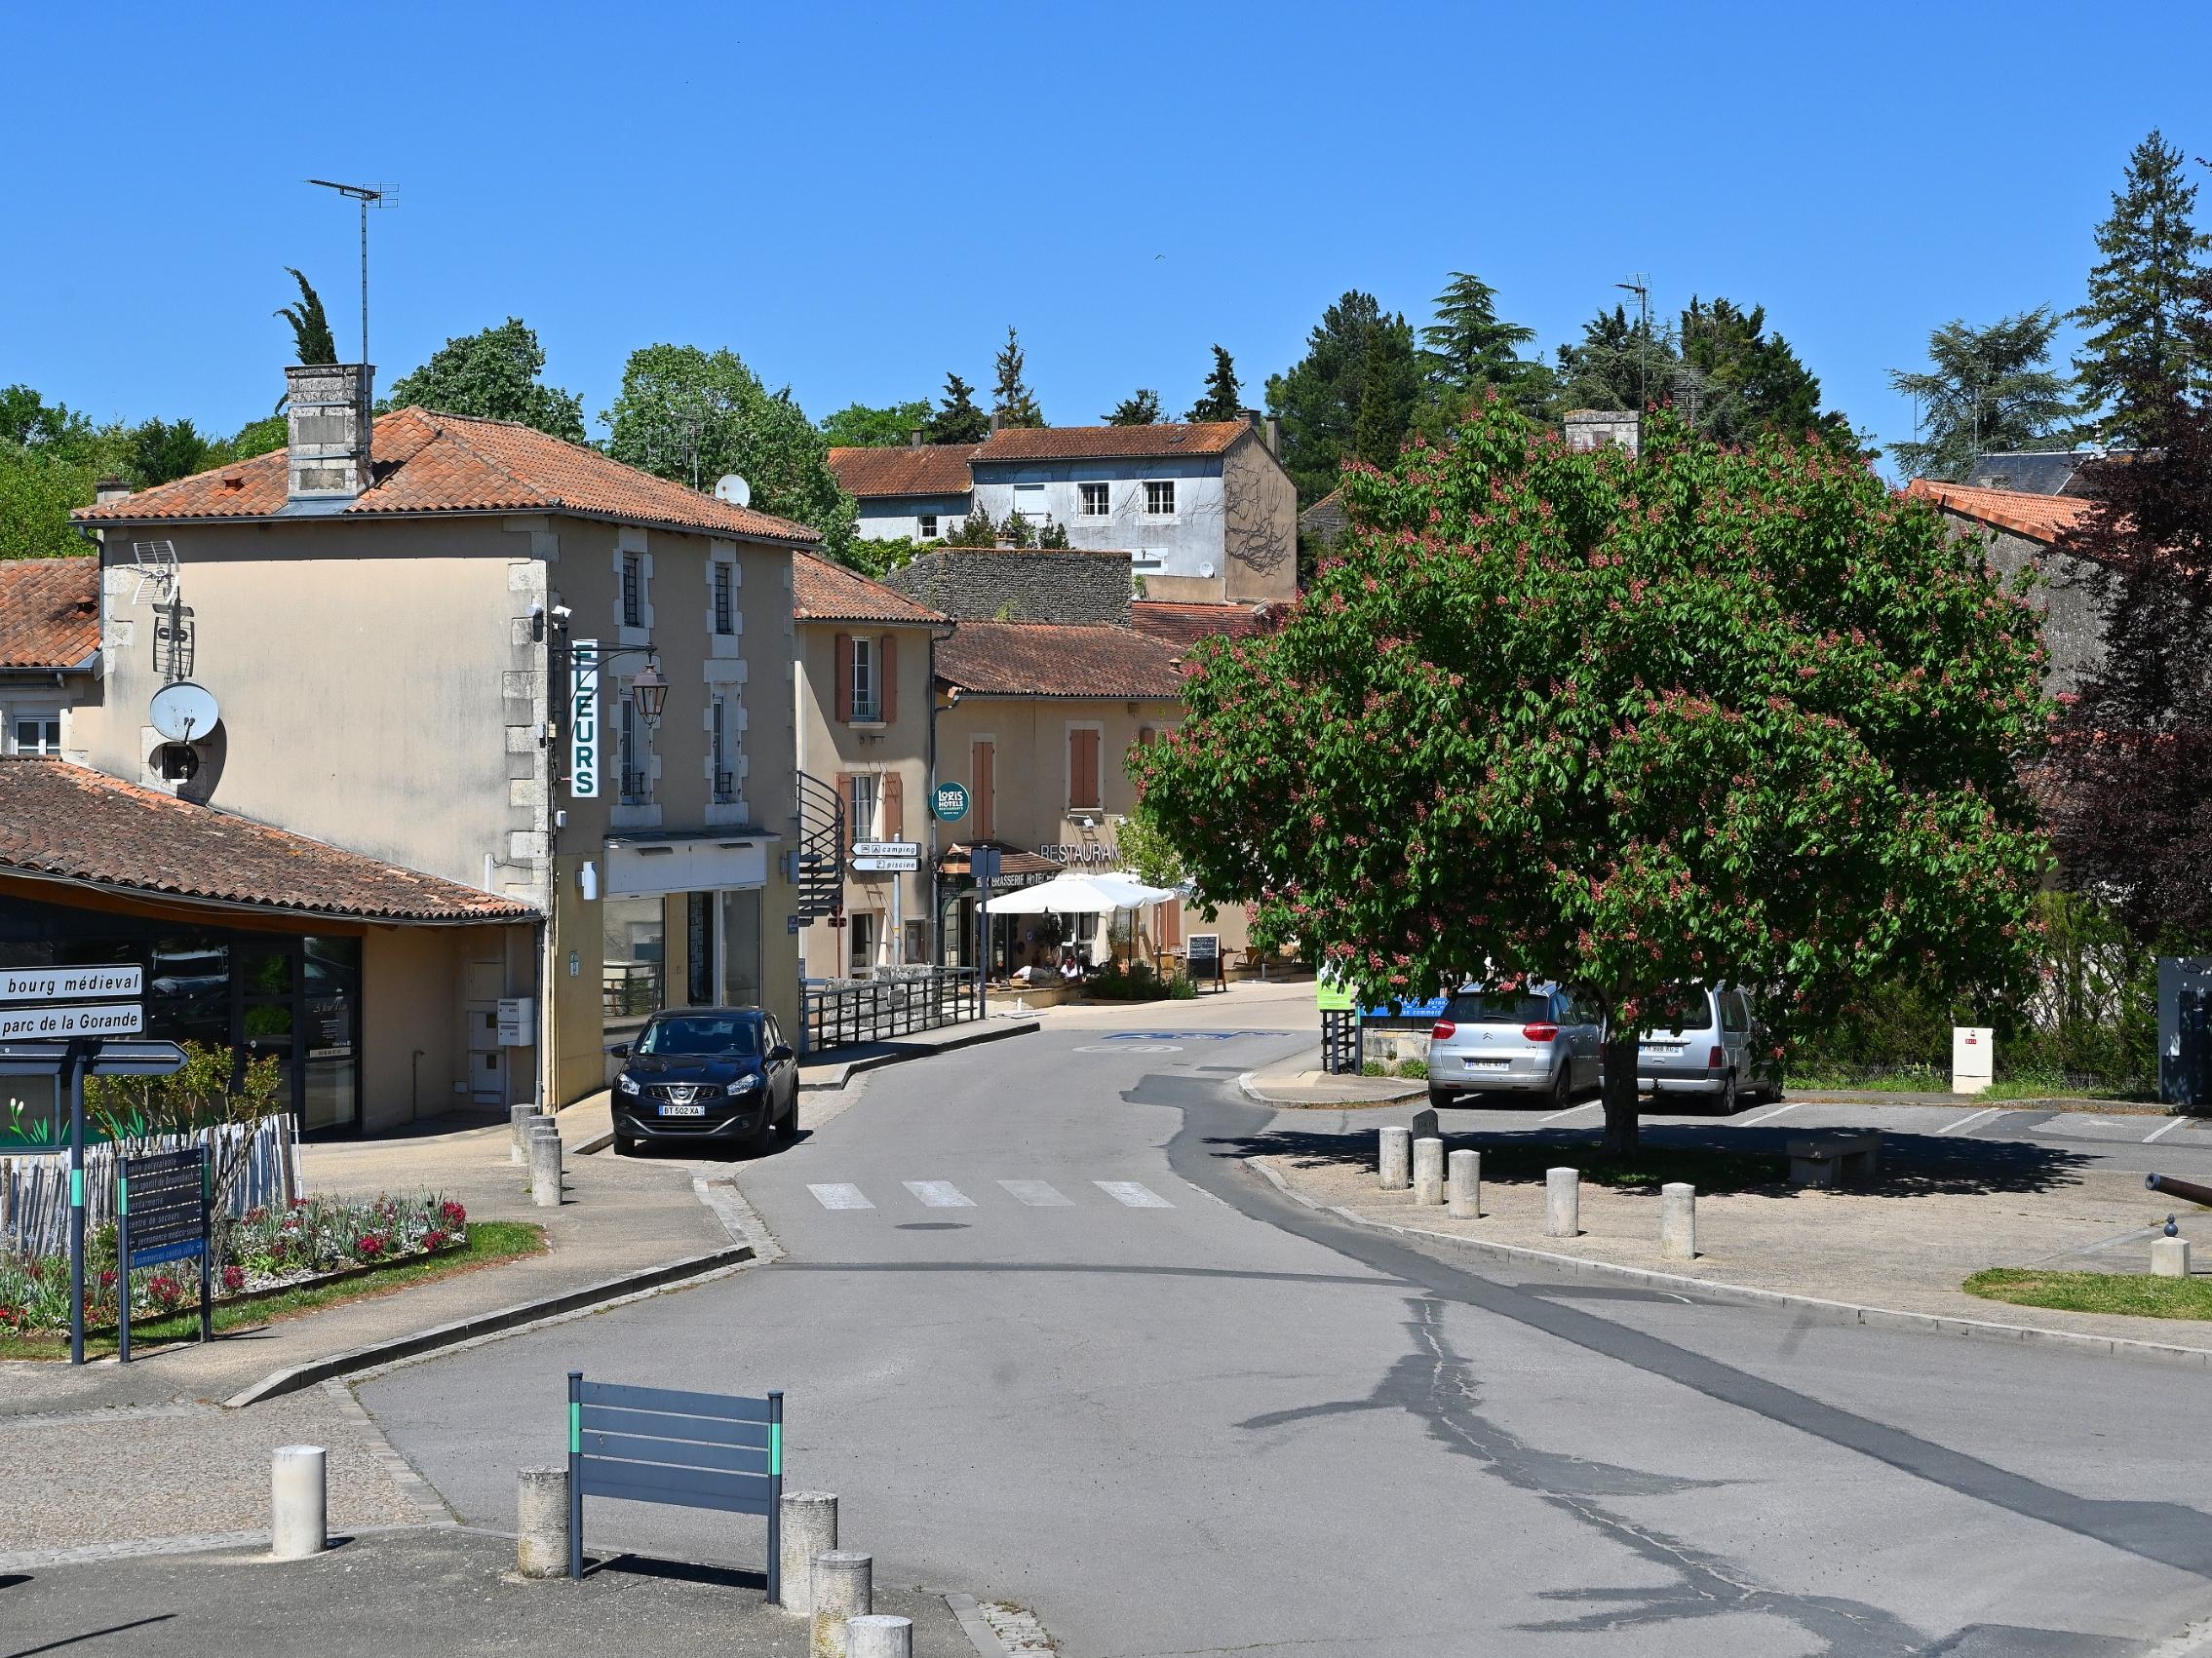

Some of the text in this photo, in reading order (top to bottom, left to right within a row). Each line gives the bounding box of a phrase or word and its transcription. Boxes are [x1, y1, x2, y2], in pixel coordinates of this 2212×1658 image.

[576, 644, 594, 794] FLEURS
[1040, 843, 1120, 863] RESTAURAN
[991, 873, 1024, 887] BRASSERIE
[8, 978, 56, 995] bourg
[2, 1012, 137, 1037] parc de la Gorande
[140, 1178, 157, 1192] sportif
[158, 1177, 164, 1186] de
[148, 1215, 156, 1225] de
[158, 1213, 179, 1223] secours
